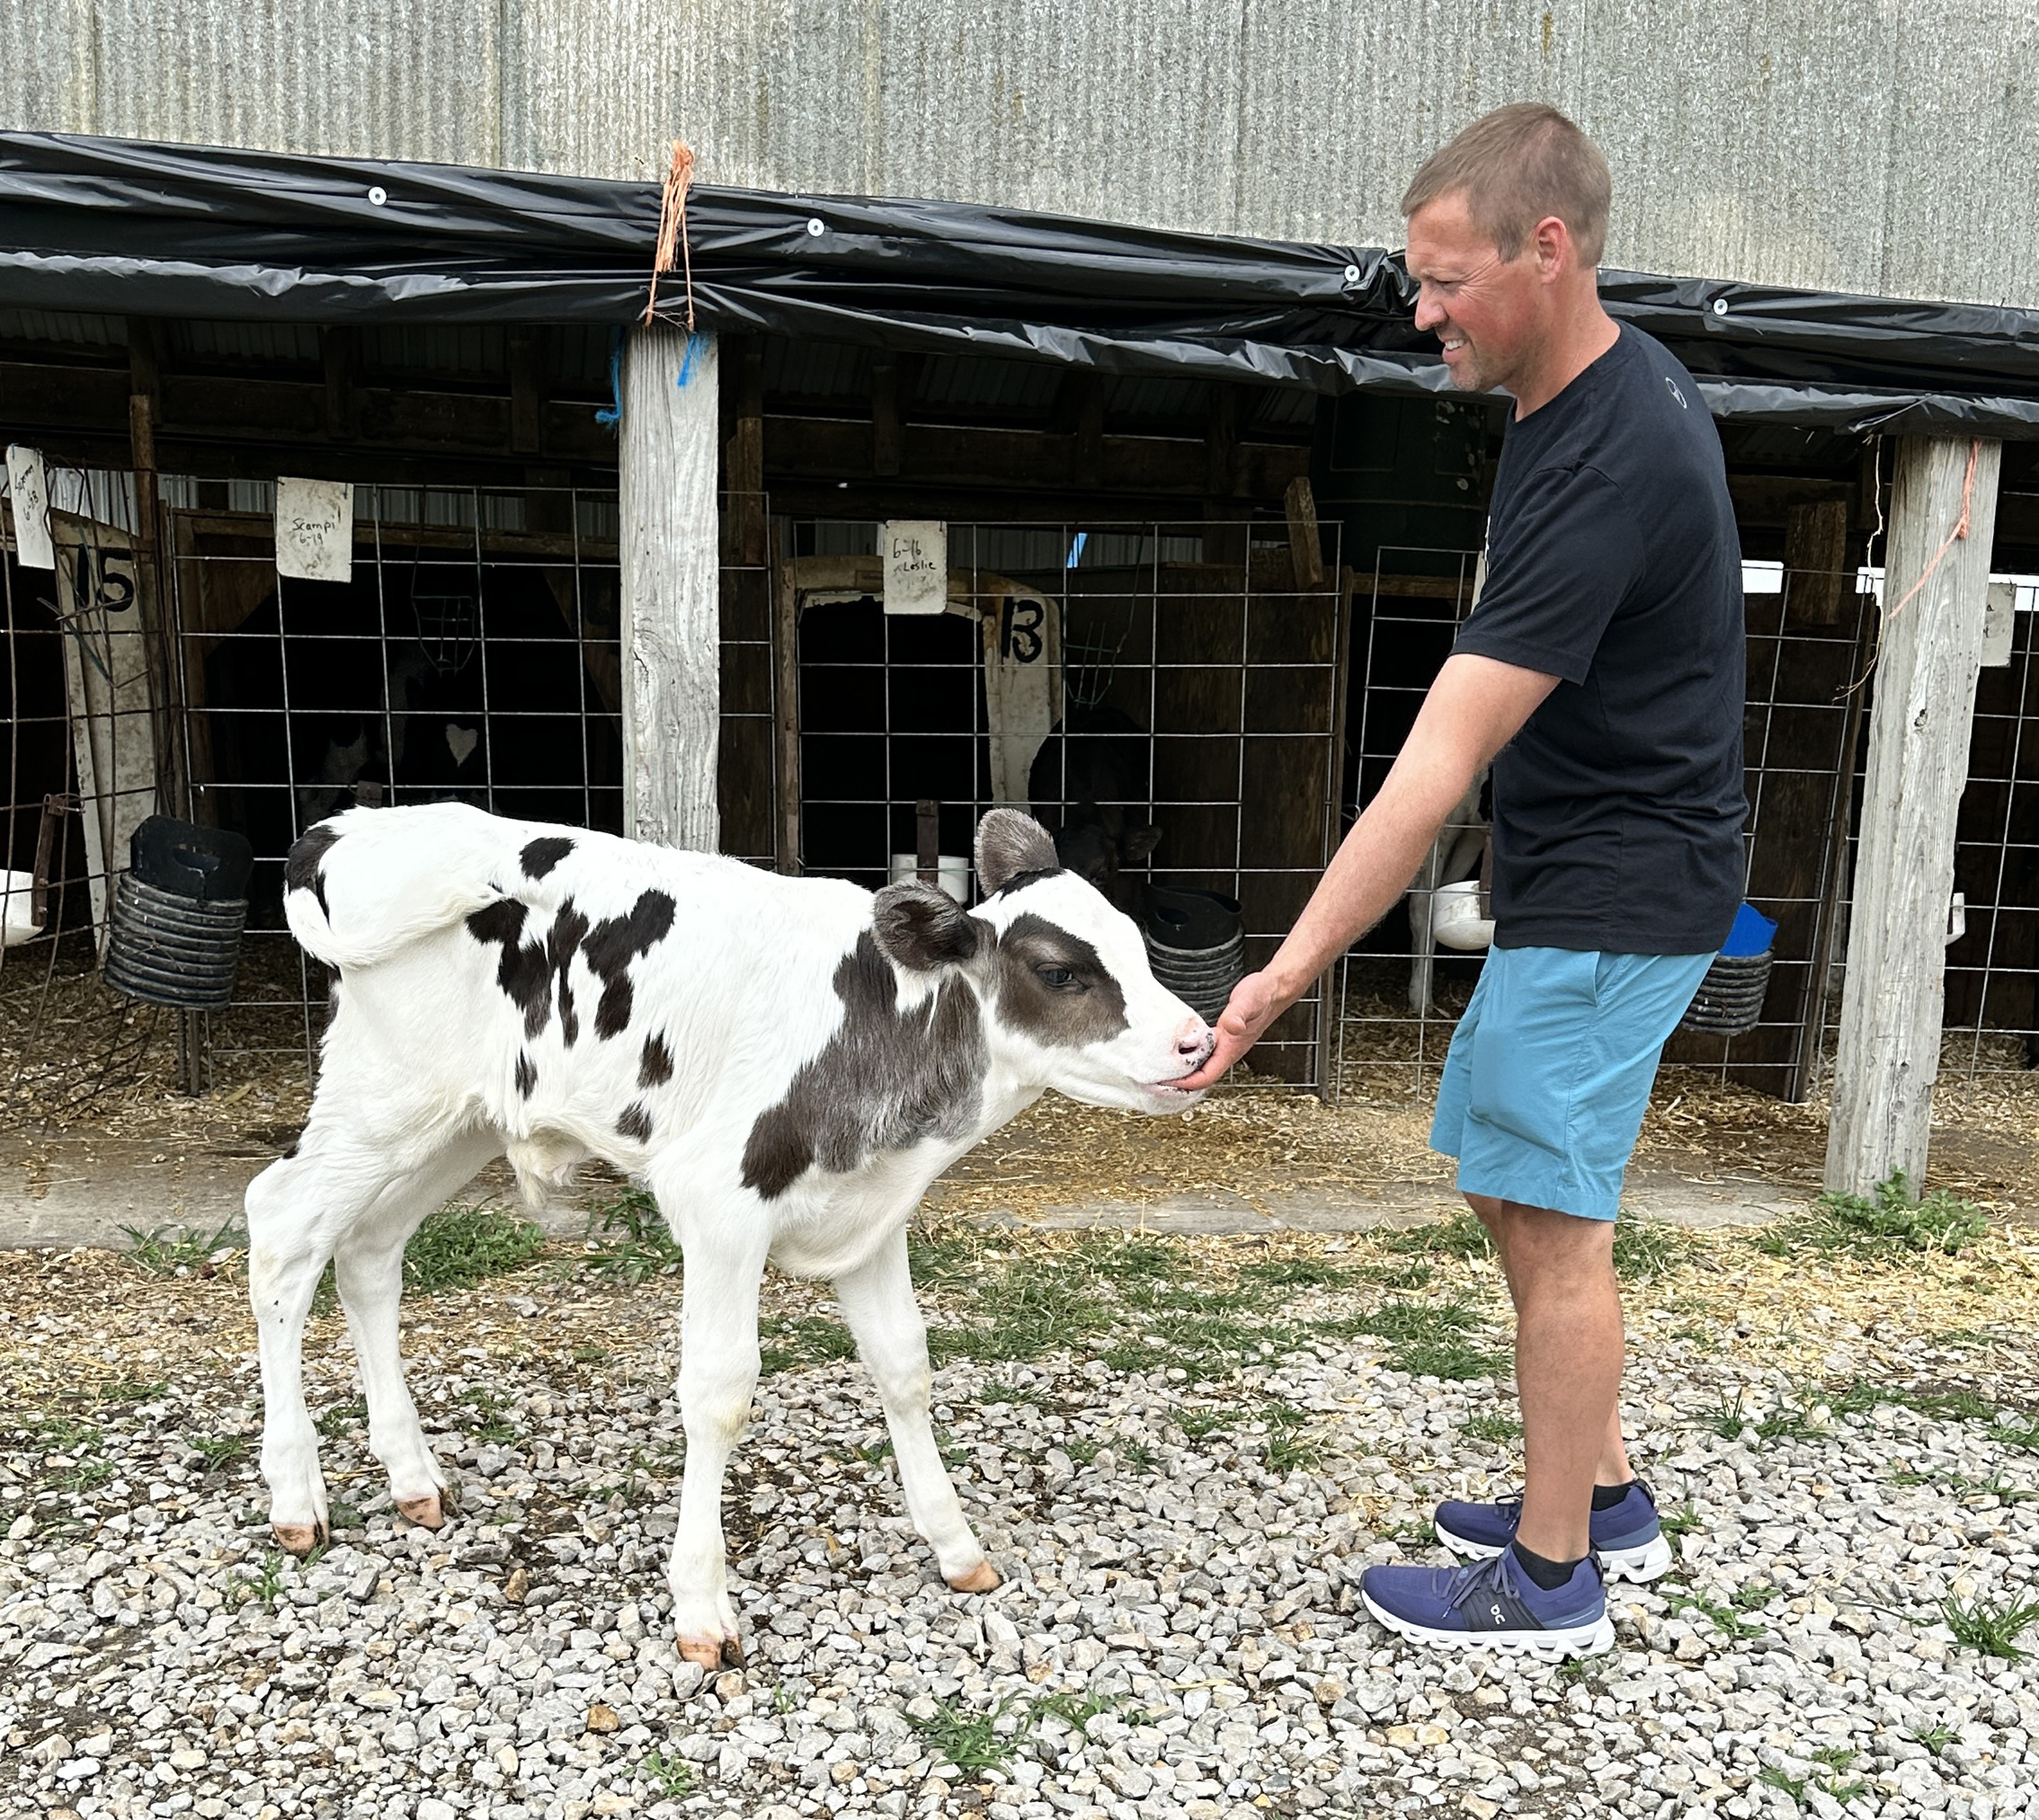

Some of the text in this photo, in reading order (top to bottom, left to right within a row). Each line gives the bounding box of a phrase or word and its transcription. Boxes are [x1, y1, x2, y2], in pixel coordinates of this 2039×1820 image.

[292, 515, 336, 534] Scampi
[893, 538, 922, 559] 6-16
[904, 559, 937, 572] Leslie
[77, 544, 135, 612] 15
[1001, 595, 1044, 664] 13
